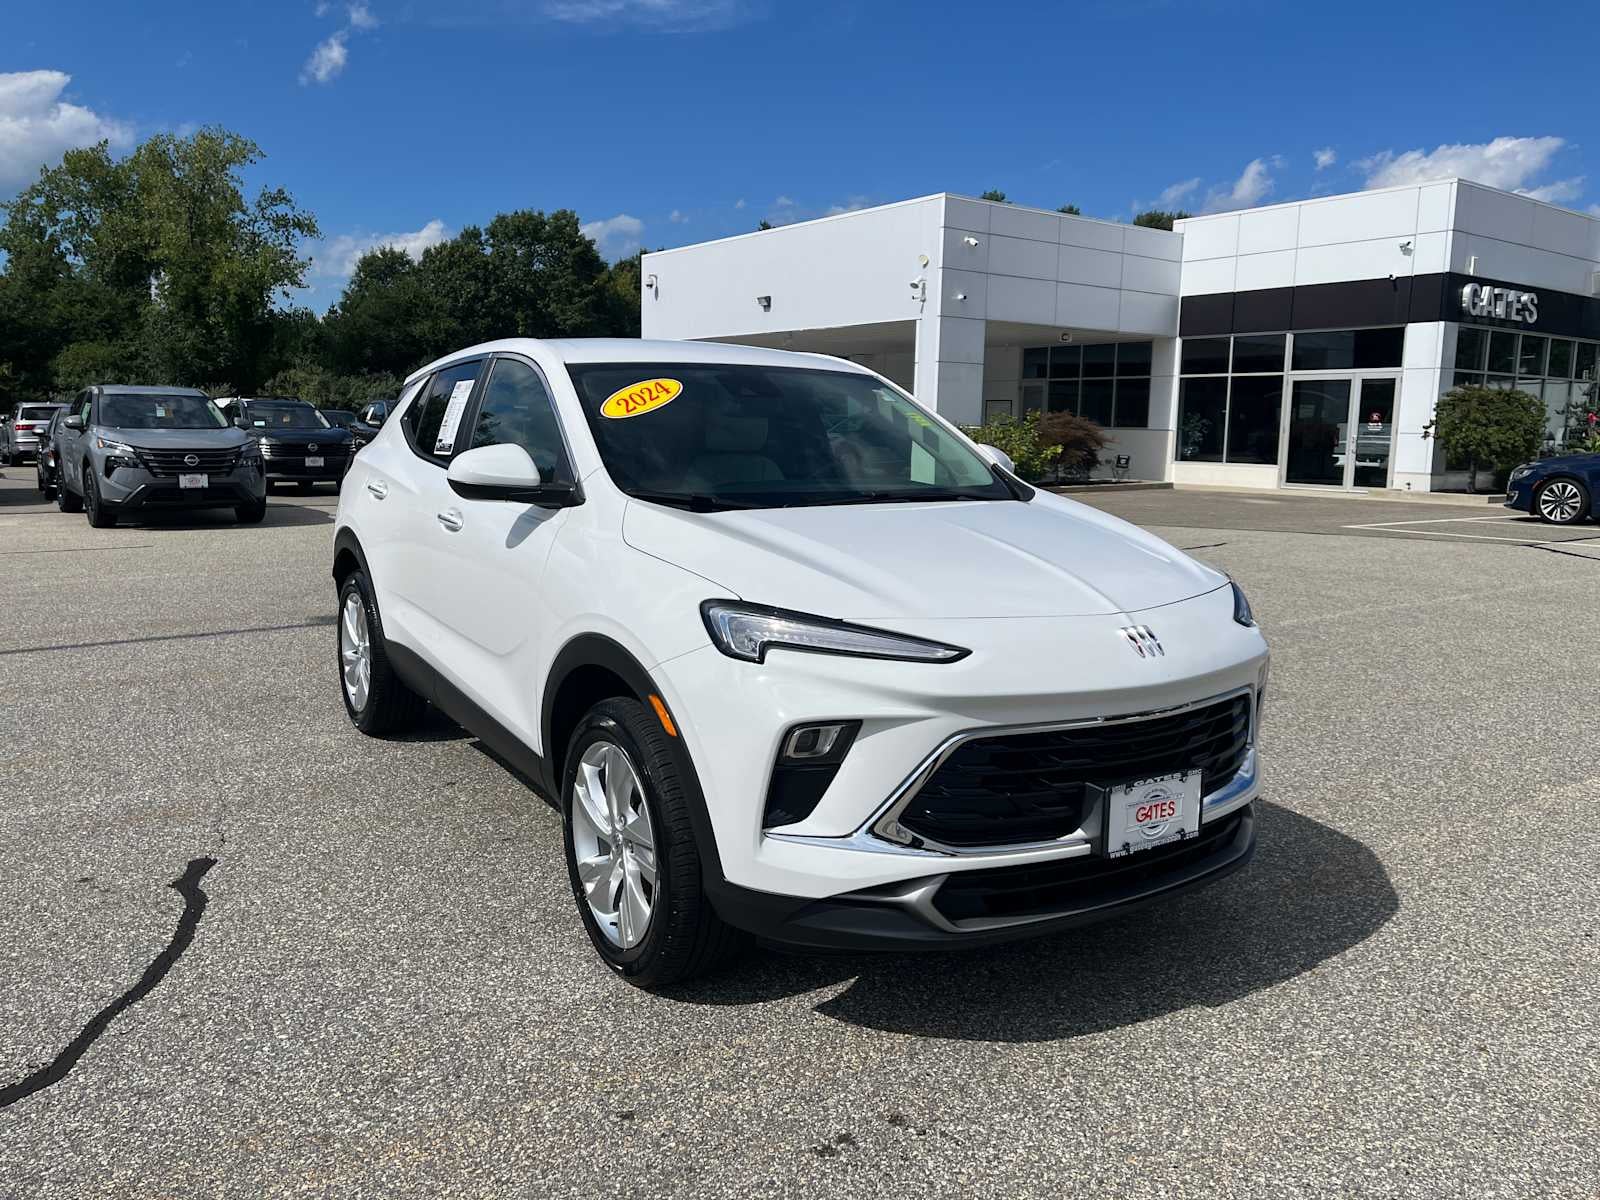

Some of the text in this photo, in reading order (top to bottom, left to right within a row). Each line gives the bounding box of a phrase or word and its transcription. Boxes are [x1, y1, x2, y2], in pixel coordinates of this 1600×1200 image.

[1462, 283, 1538, 324] GATES
[616, 382, 671, 413] 2024
[1134, 772, 1181, 786] GATES
[1136, 801, 1175, 823] GATES
